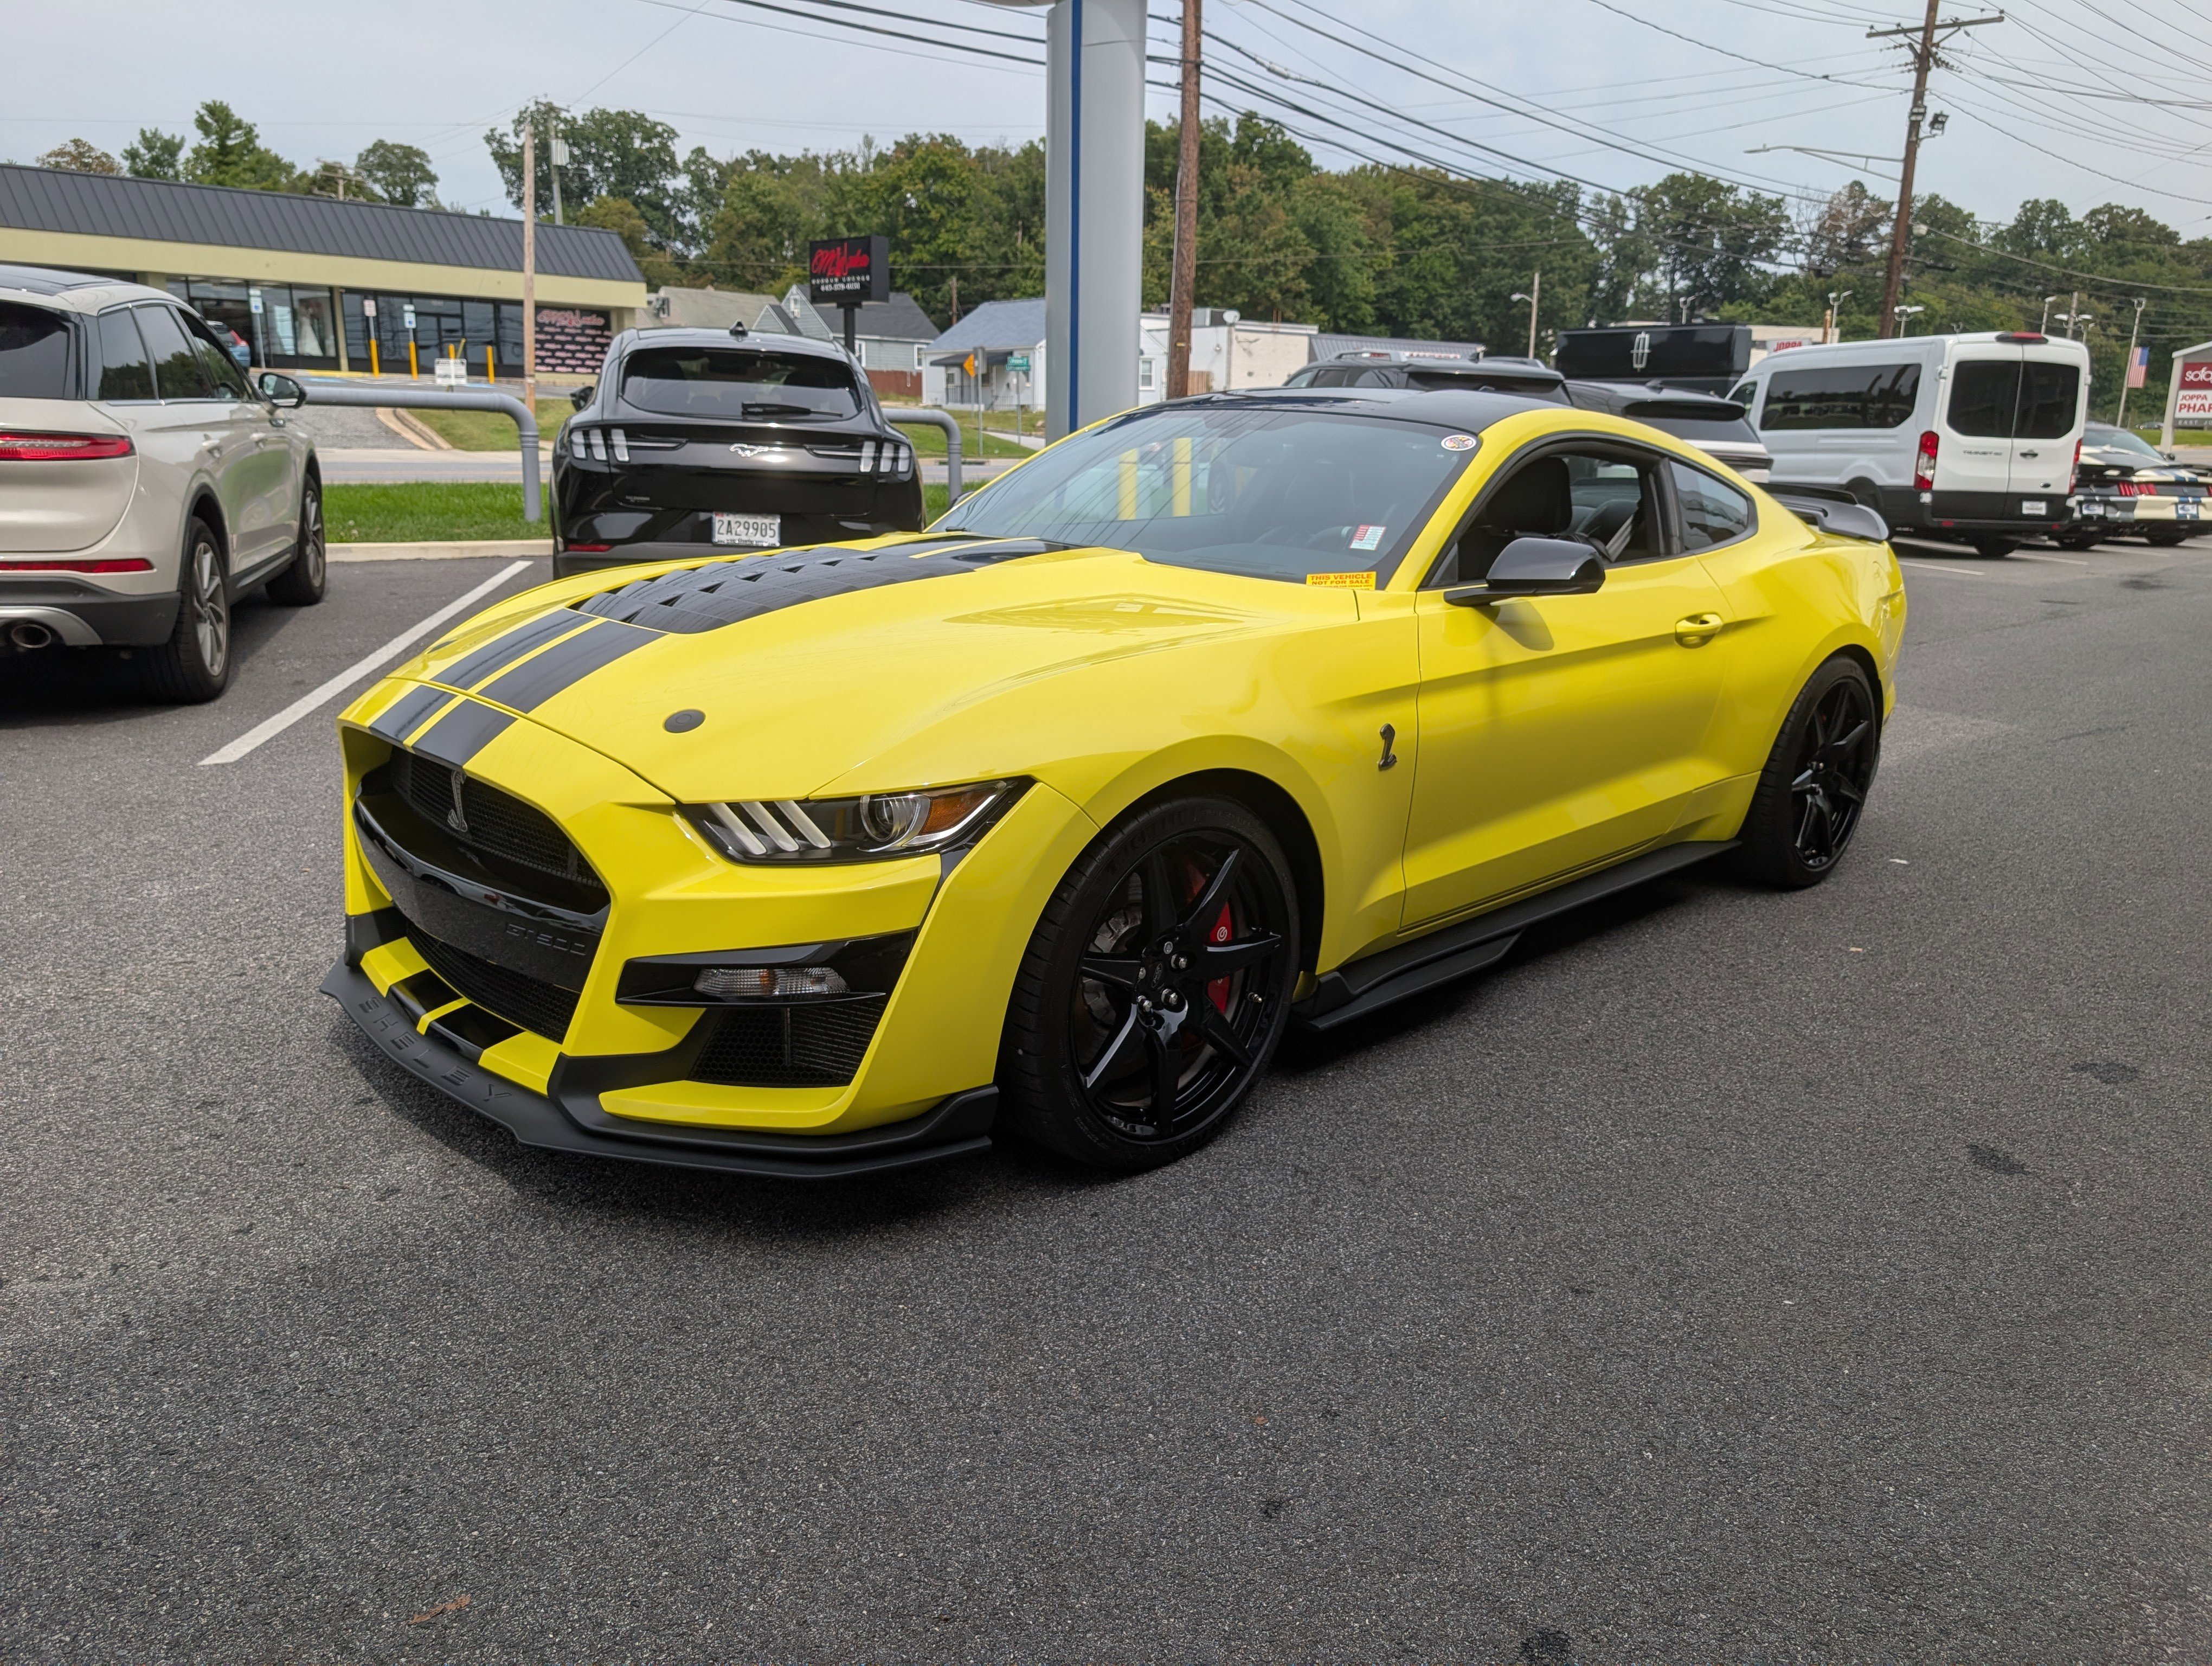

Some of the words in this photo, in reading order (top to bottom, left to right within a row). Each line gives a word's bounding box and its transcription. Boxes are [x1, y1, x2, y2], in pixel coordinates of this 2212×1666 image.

[717, 520, 776, 538] 2A29905
[506, 923, 587, 957] GT500
[358, 996, 514, 1103] SHELBY
